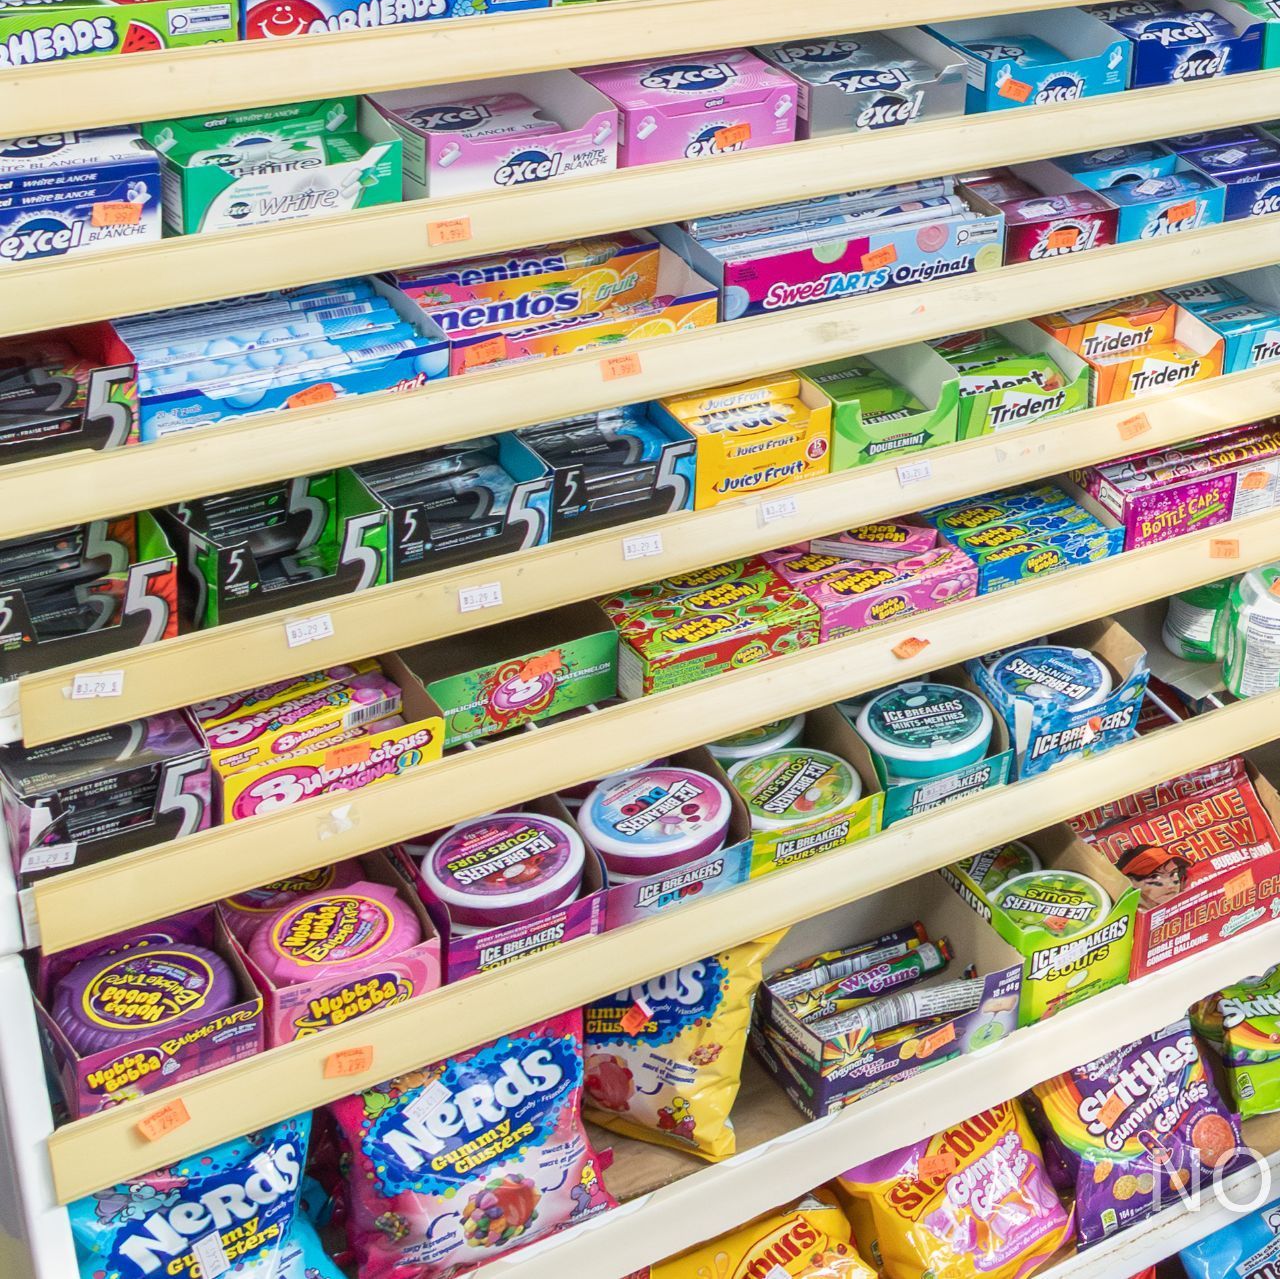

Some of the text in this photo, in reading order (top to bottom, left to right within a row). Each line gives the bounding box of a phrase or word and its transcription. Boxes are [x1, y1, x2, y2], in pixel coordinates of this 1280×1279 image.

[641, 62, 738, 92] excel
[857, 91, 923, 127] excel
[494, 151, 562, 186] excel
[564, 154, 608, 172] BLANCHE
[1, 217, 83, 261] excel
[88, 224, 147, 242] BLANCHE
[431, 286, 582, 334] mentos
[1084, 326, 1153, 357] Trident
[1130, 359, 1200, 392] Trident
[86, 365, 136, 451] 5
[990, 390, 1065, 426] Trident
[869, 434, 925, 456] DOUBLEMINT
[717, 459, 808, 494] Juicy Fruit
[1141, 487, 1221, 539] BOTTLE CAPS
[883, 699, 962, 723] ICE BREAKERS
[1141, 789, 1245, 847] LEAGUE
[1178, 819, 1257, 860] CHEW
[1213, 843, 1273, 871] BUBBLE GUM
[638, 859, 723, 905] ICE BREAKERS
[1148, 922, 1180, 947] BIG
[1182, 887, 1258, 933] LEAGUE
[479, 923, 564, 965] ICE BREAKERS
[840, 964, 921, 995] Wine Gums
[1105, 1082, 1181, 1151] Gummies
[454, 1121, 535, 1176] Clusters
